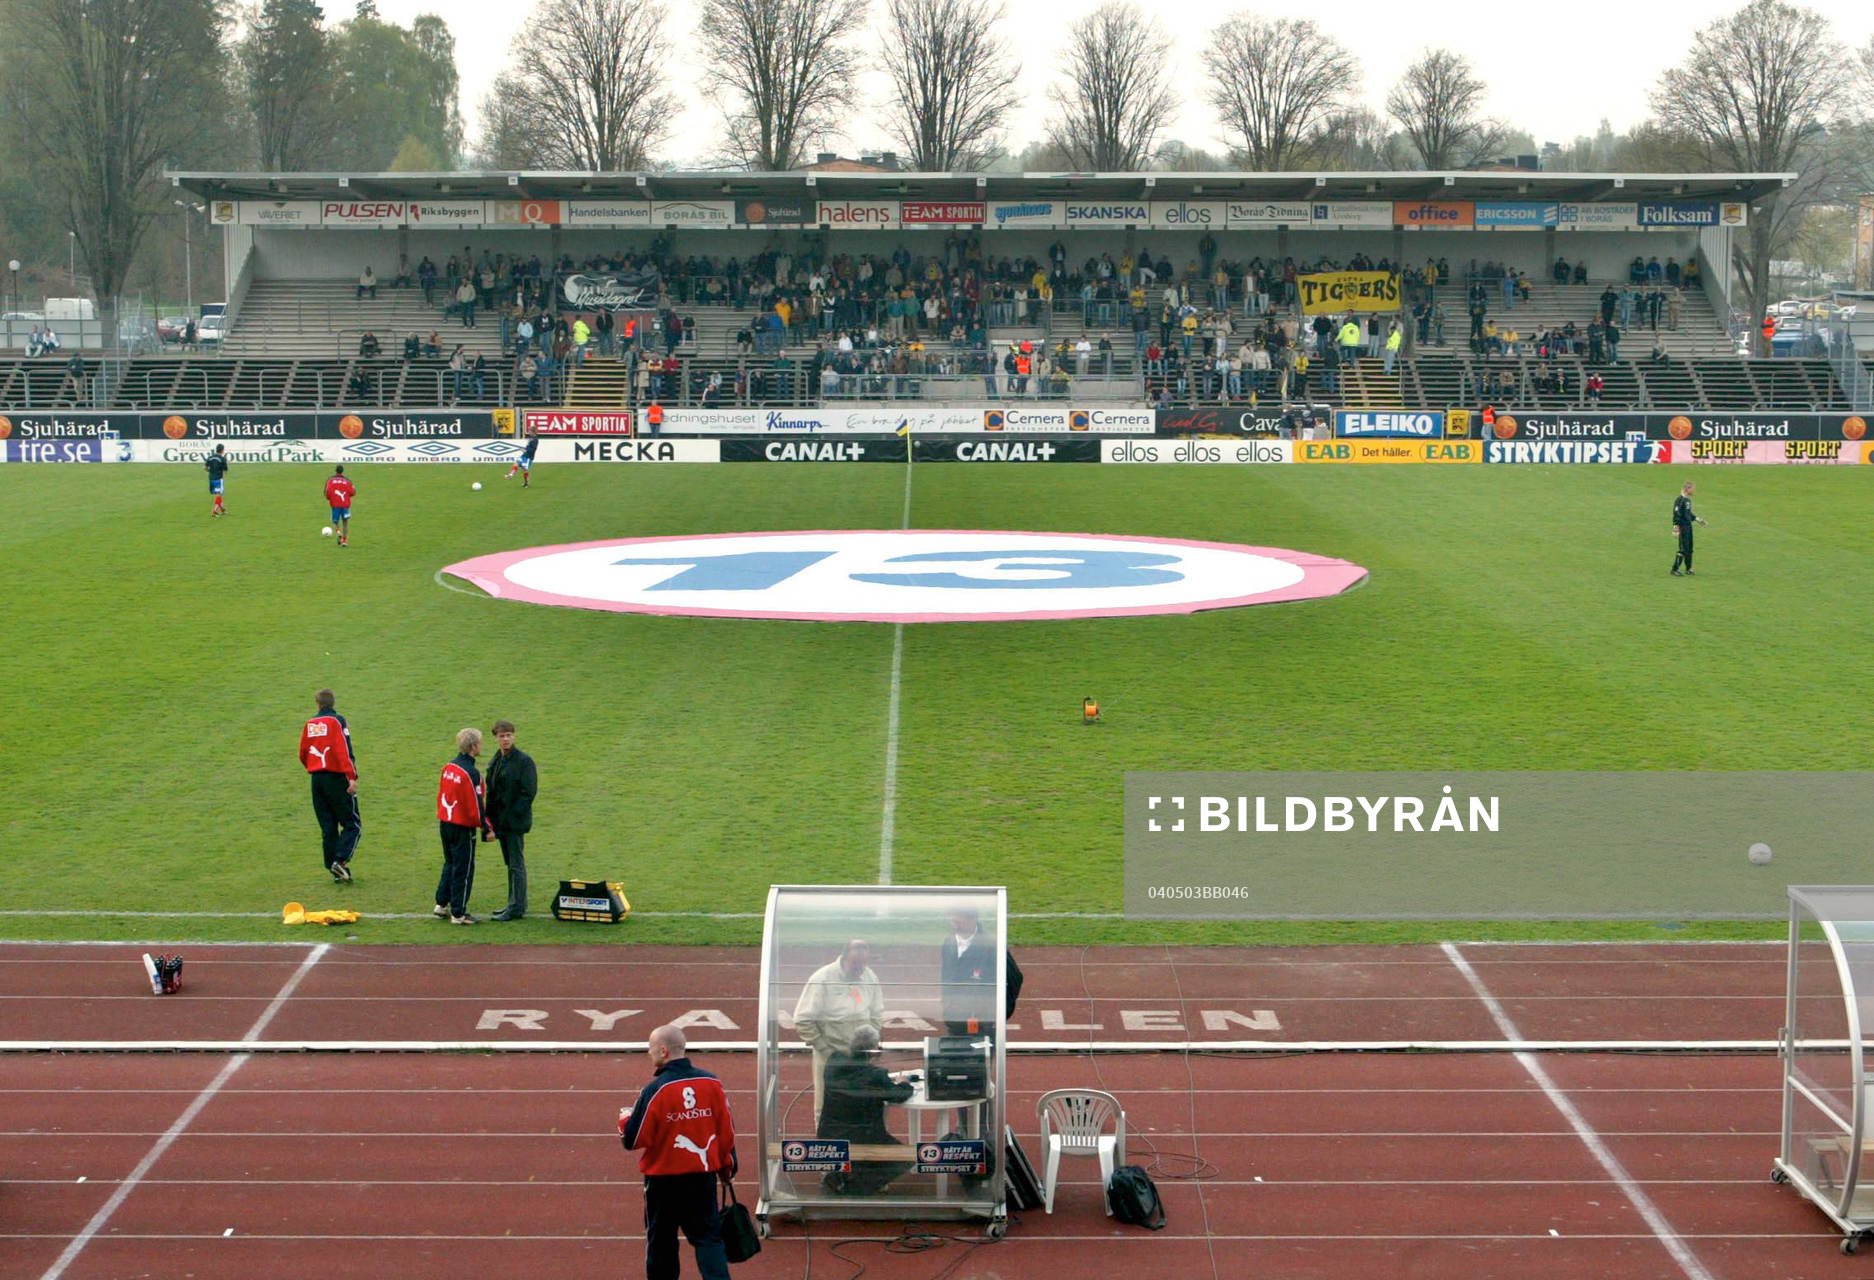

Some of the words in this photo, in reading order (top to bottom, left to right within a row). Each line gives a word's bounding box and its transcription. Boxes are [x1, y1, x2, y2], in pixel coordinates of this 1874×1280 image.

[324, 203, 403, 218] PULSEN
[421, 207, 479, 218] Riksbyggen
[570, 206, 648, 217] Handelsbanken
[710, 211, 728, 219] BIL
[819, 202, 890, 222] halens
[904, 206, 943, 218] TEAM
[947, 206, 983, 218] SPORTIA
[1068, 206, 1147, 219] SKANSKA
[1166, 202, 1212, 223] ellos
[1408, 205, 1458, 220] office
[1476, 208, 1537, 219] ERICSSON
[1643, 206, 1712, 223] Folksam
[1302, 274, 1397, 306] TIGERS
[527, 415, 577, 431] TEAM
[582, 415, 627, 431] SPORTIA
[661, 413, 756, 425] edningshuset
[1006, 411, 1064, 424] Cernera
[1091, 411, 1149, 424] Cernera
[1345, 414, 1433, 435] ELEIKO
[20, 420, 109, 440] Sjuhärad
[196, 420, 285, 440] Sjuhärad
[372, 419, 462, 439] Sjuhärad
[1526, 420, 1615, 440] Sjuhärad
[1701, 420, 1789, 440] Sjuhärad
[19, 439, 91, 463] tre.se
[277, 447, 324, 462] Park
[575, 442, 674, 461] MECKA
[765, 442, 865, 461] CANAL+
[957, 442, 1056, 461] CANAL+
[1112, 441, 1159, 462] ellos
[1174, 441, 1220, 462] ellos
[1236, 441, 1283, 462] ellos
[1306, 444, 1350, 459] EAB
[1362, 447, 1380, 457] Det
[1426, 444, 1471, 459] EAB
[1489, 441, 1638, 463] STRYKTIPSET
[1691, 440, 1748, 459] SPORT
[1785, 440, 1842, 459] SPORT
[612, 550, 1184, 591] 13
[475, 1009, 1282, 1031] RYAALEN
[788, 1147, 802, 1156] 13
[808, 1151, 845, 1159] RESPEKT
[923, 1149, 937, 1158] 13
[943, 1152, 981, 1160] RESPEKT
